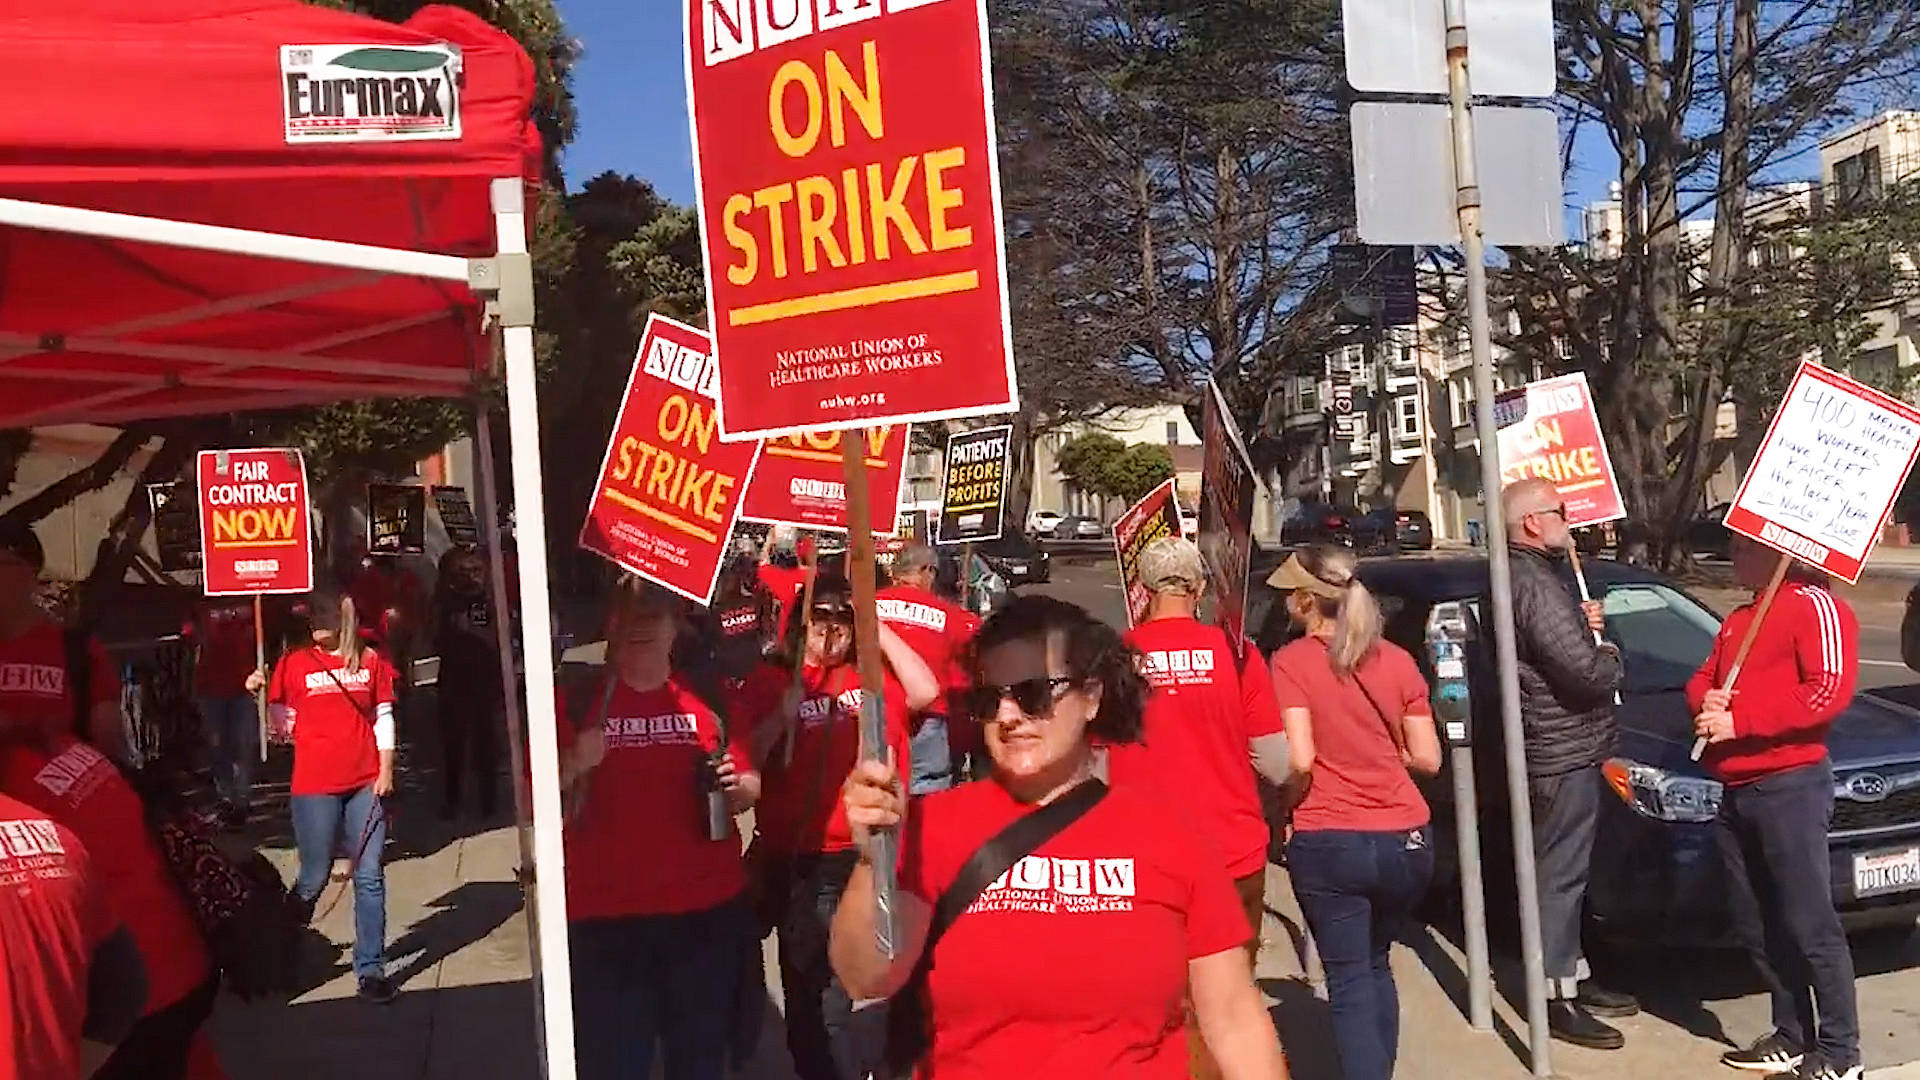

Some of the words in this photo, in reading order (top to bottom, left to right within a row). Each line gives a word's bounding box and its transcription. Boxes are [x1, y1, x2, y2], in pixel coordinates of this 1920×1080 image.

[287, 72, 443, 118] Eurmax
[769, 40, 884, 157] ON
[723, 146, 973, 286] STRIKE
[769, 361, 863, 388] HEALTHCARE
[865, 350, 943, 374] WORKERS
[776, 345, 849, 370] NATIONAL
[851, 337, 904, 359] UNION
[907, 333, 929, 350] OF
[820, 392, 886, 409] nuhw.org
[1803, 386, 1856, 428] 400
[658, 395, 718, 454] ON
[950, 437, 1004, 465] PATIENTS
[1823, 451, 1872, 476] LEFT
[233, 461, 269, 481] FAIR
[612, 436, 736, 523] STRIKE
[950, 461, 1002, 484] BEFORE
[208, 482, 298, 505] CONTRACT
[948, 482, 1000, 504] PROFITS
[212, 507, 297, 541] NOW
[1763, 522, 1827, 563] NUHW
[1008, 857, 1132, 893] UHW
[967, 899, 1056, 914] HEALTHCARE
[1065, 900, 1134, 914] WORKERS
[981, 888, 1049, 902] NATIONAL
[1052, 892, 1099, 906] UNION
